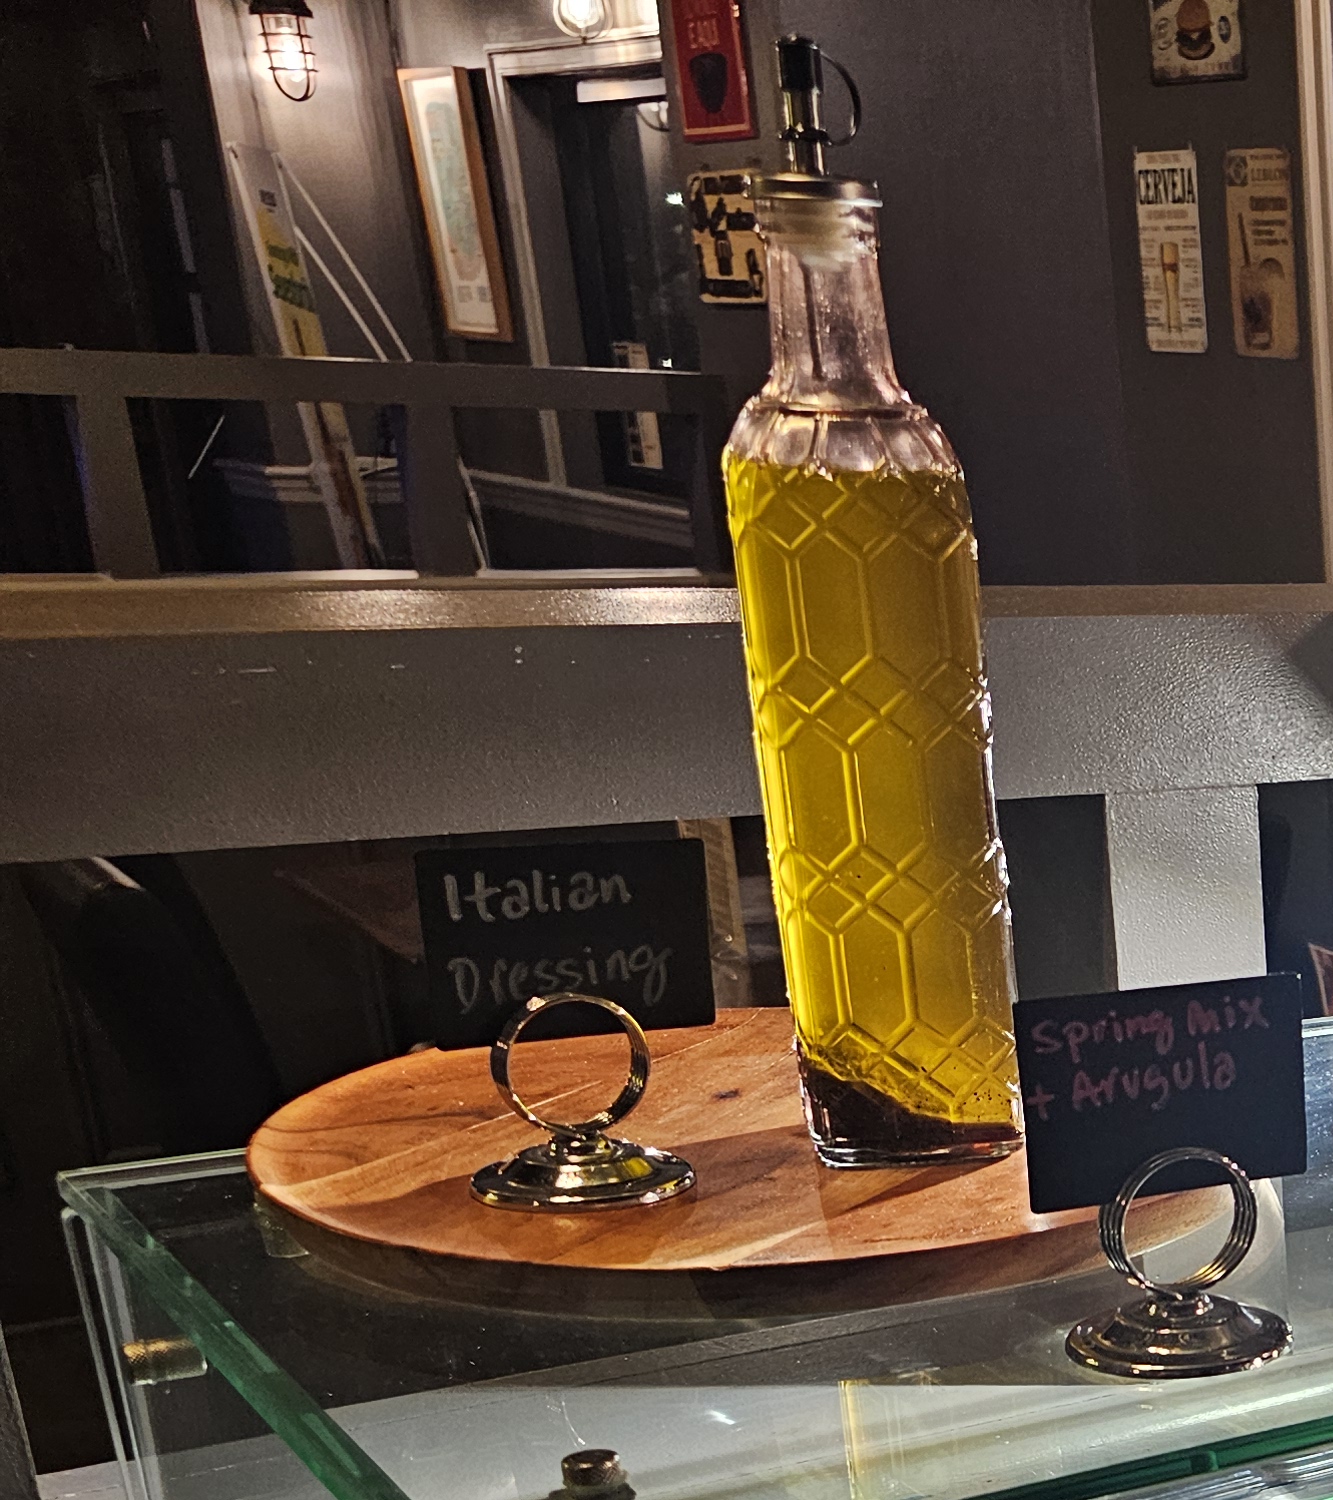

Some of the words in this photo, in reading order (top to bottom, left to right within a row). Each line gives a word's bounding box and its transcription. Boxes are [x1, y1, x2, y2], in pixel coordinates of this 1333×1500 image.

[1137, 168, 1196, 206] CERVEJA
[444, 869, 633, 923] Italian
[447, 945, 673, 1016] Dressing
[1070, 1040, 1237, 1112] Arugula
